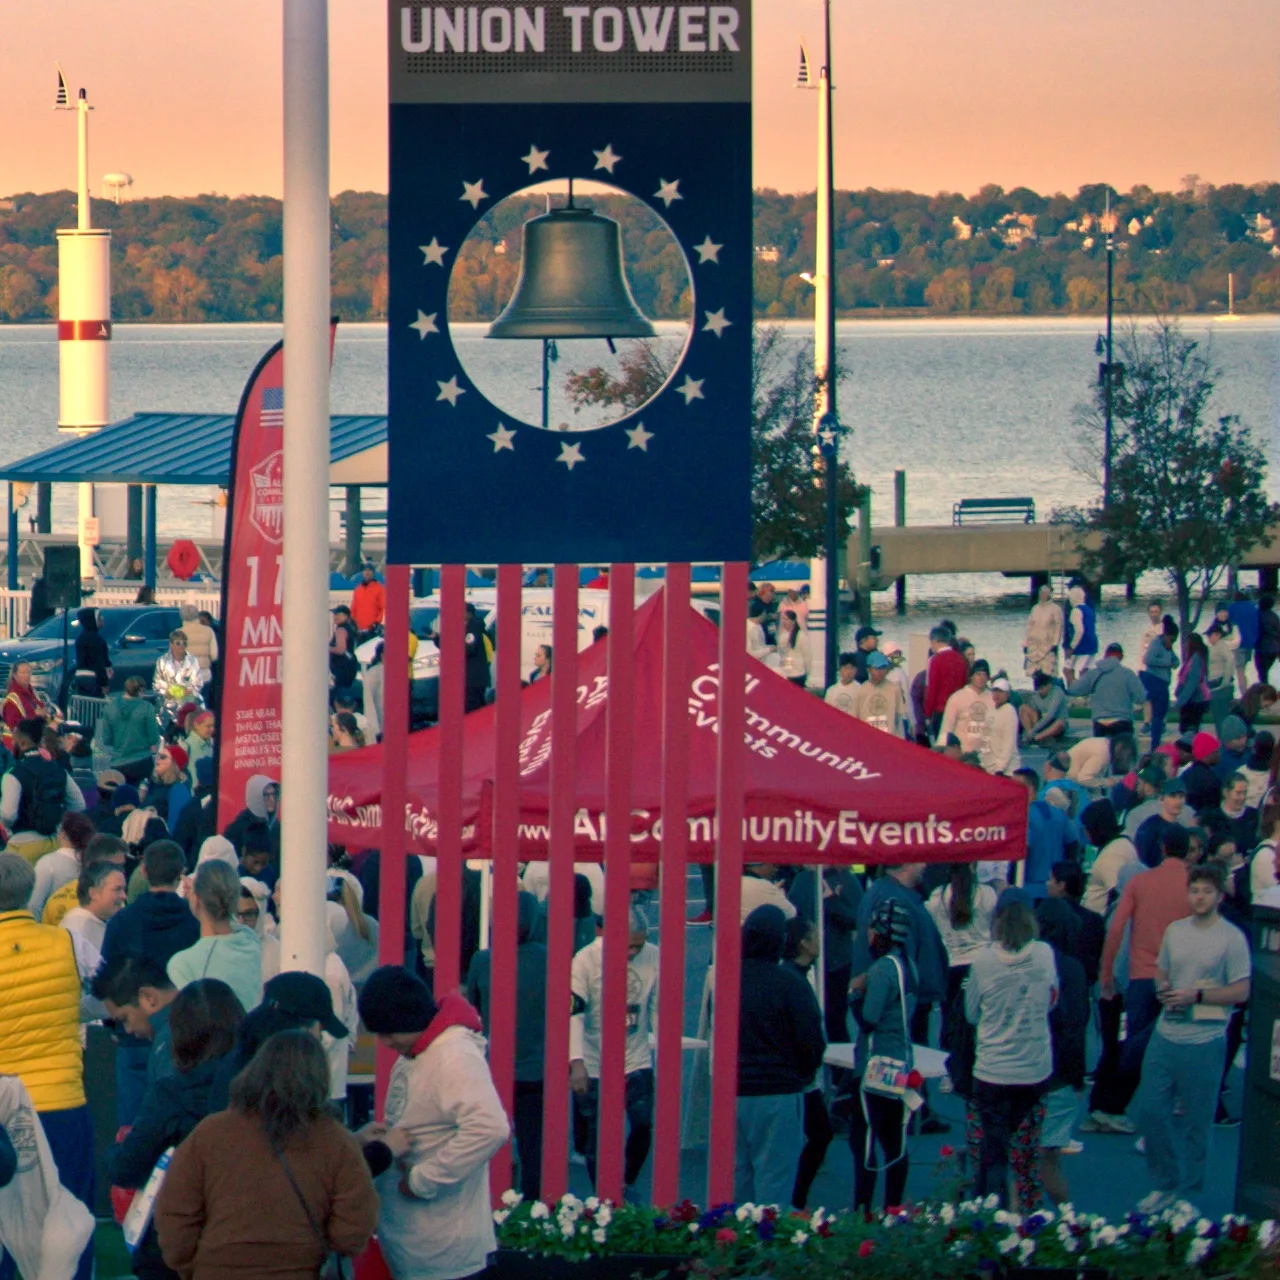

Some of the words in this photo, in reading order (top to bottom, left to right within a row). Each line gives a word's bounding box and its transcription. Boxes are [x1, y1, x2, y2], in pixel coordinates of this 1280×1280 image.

[400, 6, 545, 54] UNION
[562, 6, 740, 53] TOWER
[691, 675, 882, 781] Cmmunity
